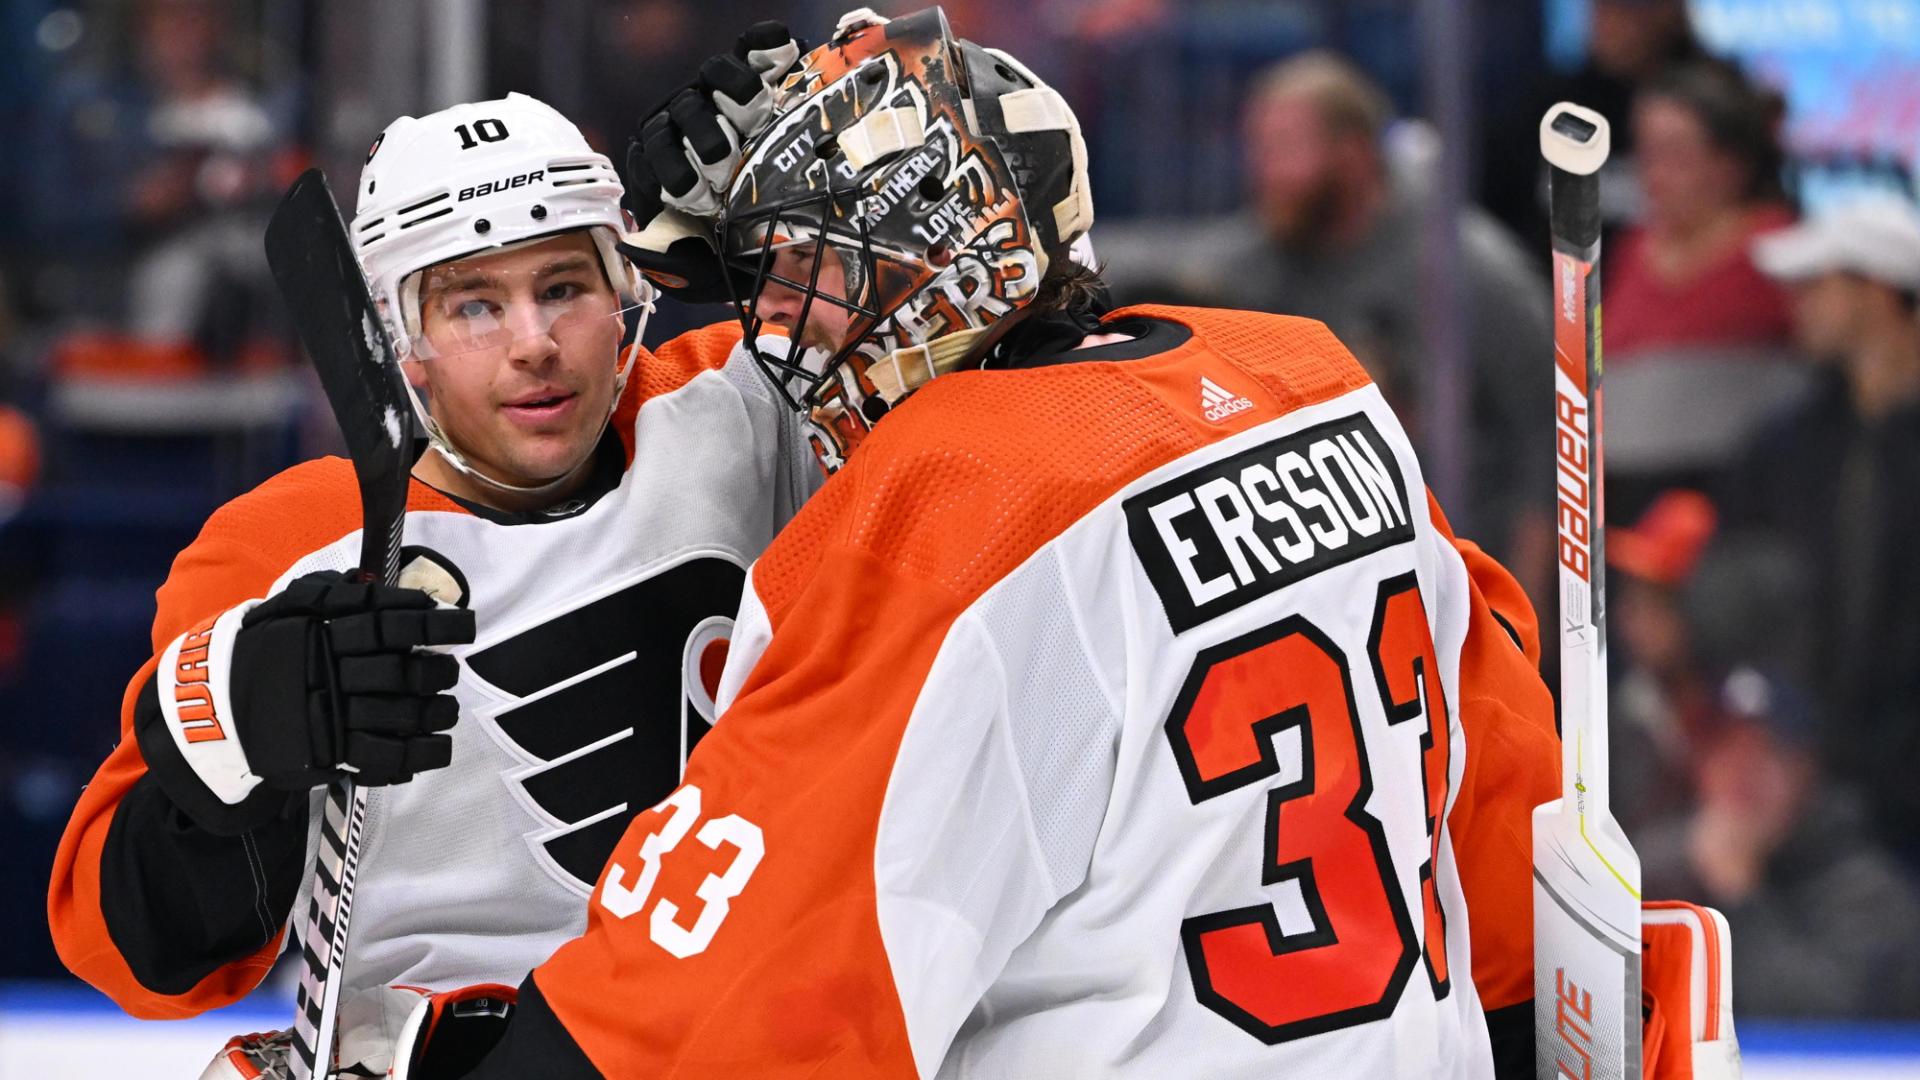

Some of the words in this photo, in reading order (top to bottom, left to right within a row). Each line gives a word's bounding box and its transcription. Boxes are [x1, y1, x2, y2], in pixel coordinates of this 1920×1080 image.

[454, 118, 510, 150] 10
[458, 169, 546, 202] BAUER
[774, 129, 815, 173] CITY
[918, 193, 972, 245] LOVE
[1204, 397, 1253, 421] adidas
[1147, 429, 1407, 607] ERSSON
[1556, 390, 1590, 584] BAUER
[1164, 566, 1452, 1047] 33
[331, 796, 366, 971] WARRIOR
[600, 783, 766, 960] 33
